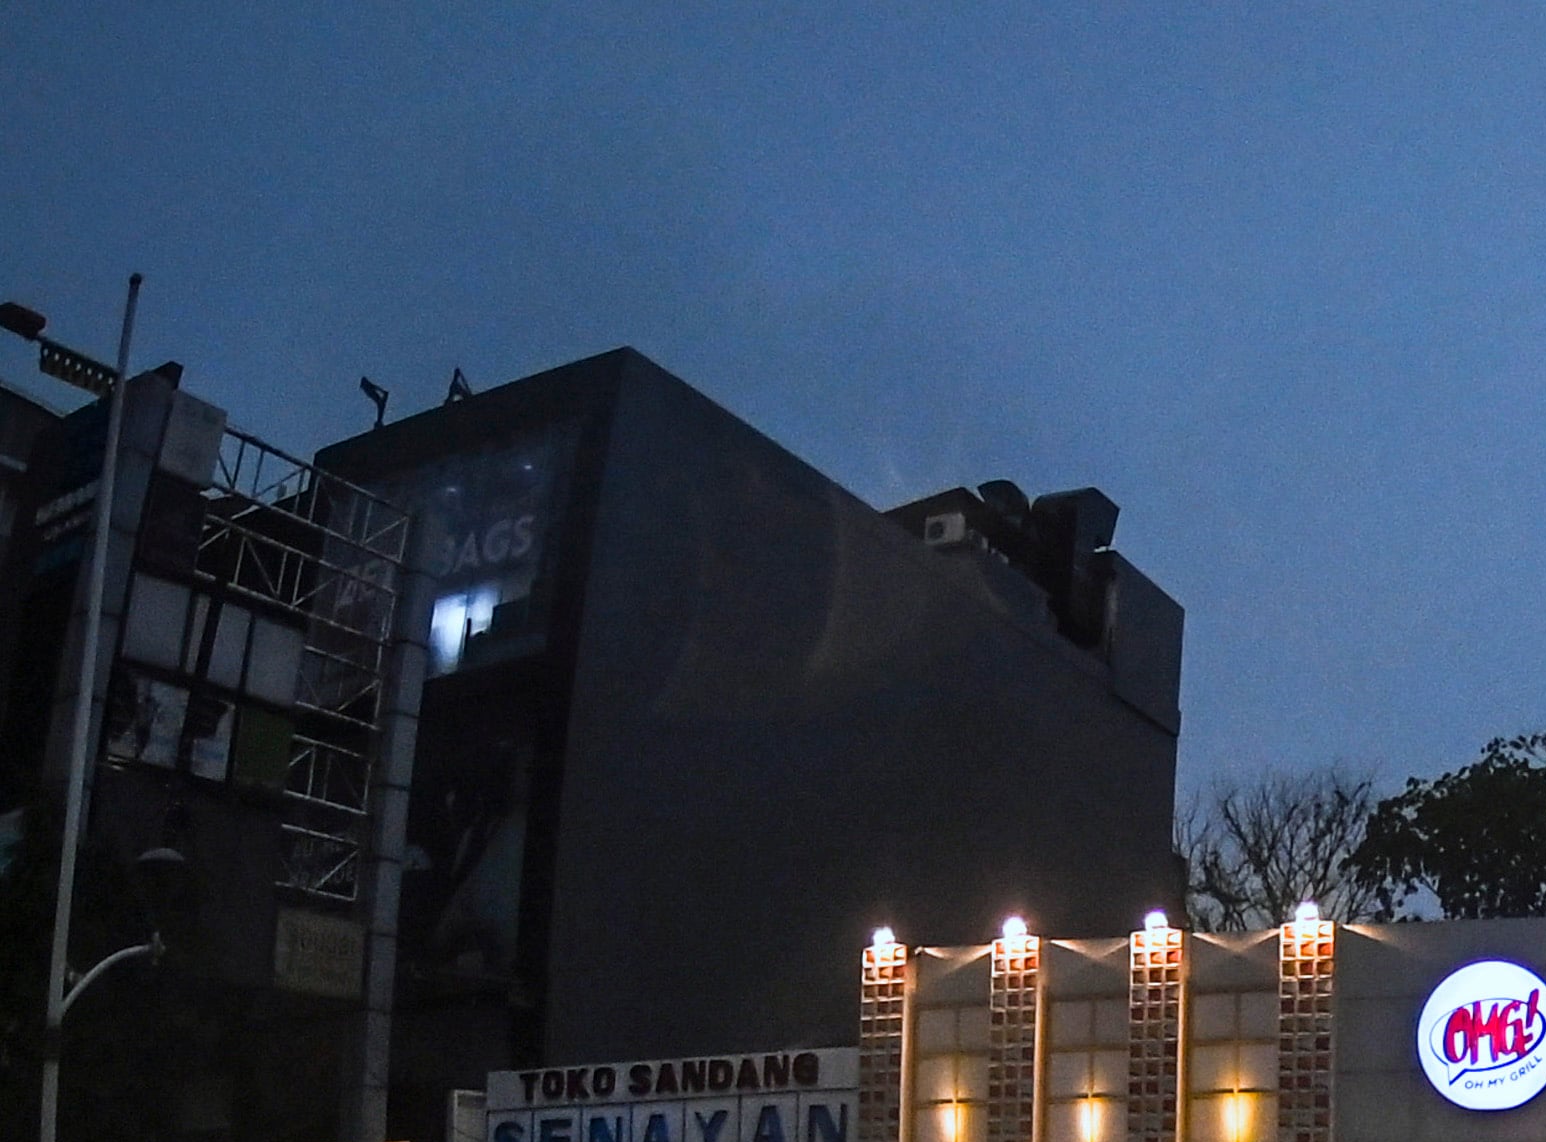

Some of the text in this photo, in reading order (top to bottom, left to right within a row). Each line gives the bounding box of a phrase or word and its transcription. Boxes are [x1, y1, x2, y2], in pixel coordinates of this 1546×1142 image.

[1443, 989, 1539, 1065] OMG!
[519, 1052, 820, 1101] TOKO SANDANG
[1464, 1055, 1543, 1090] OH MY GRILL
